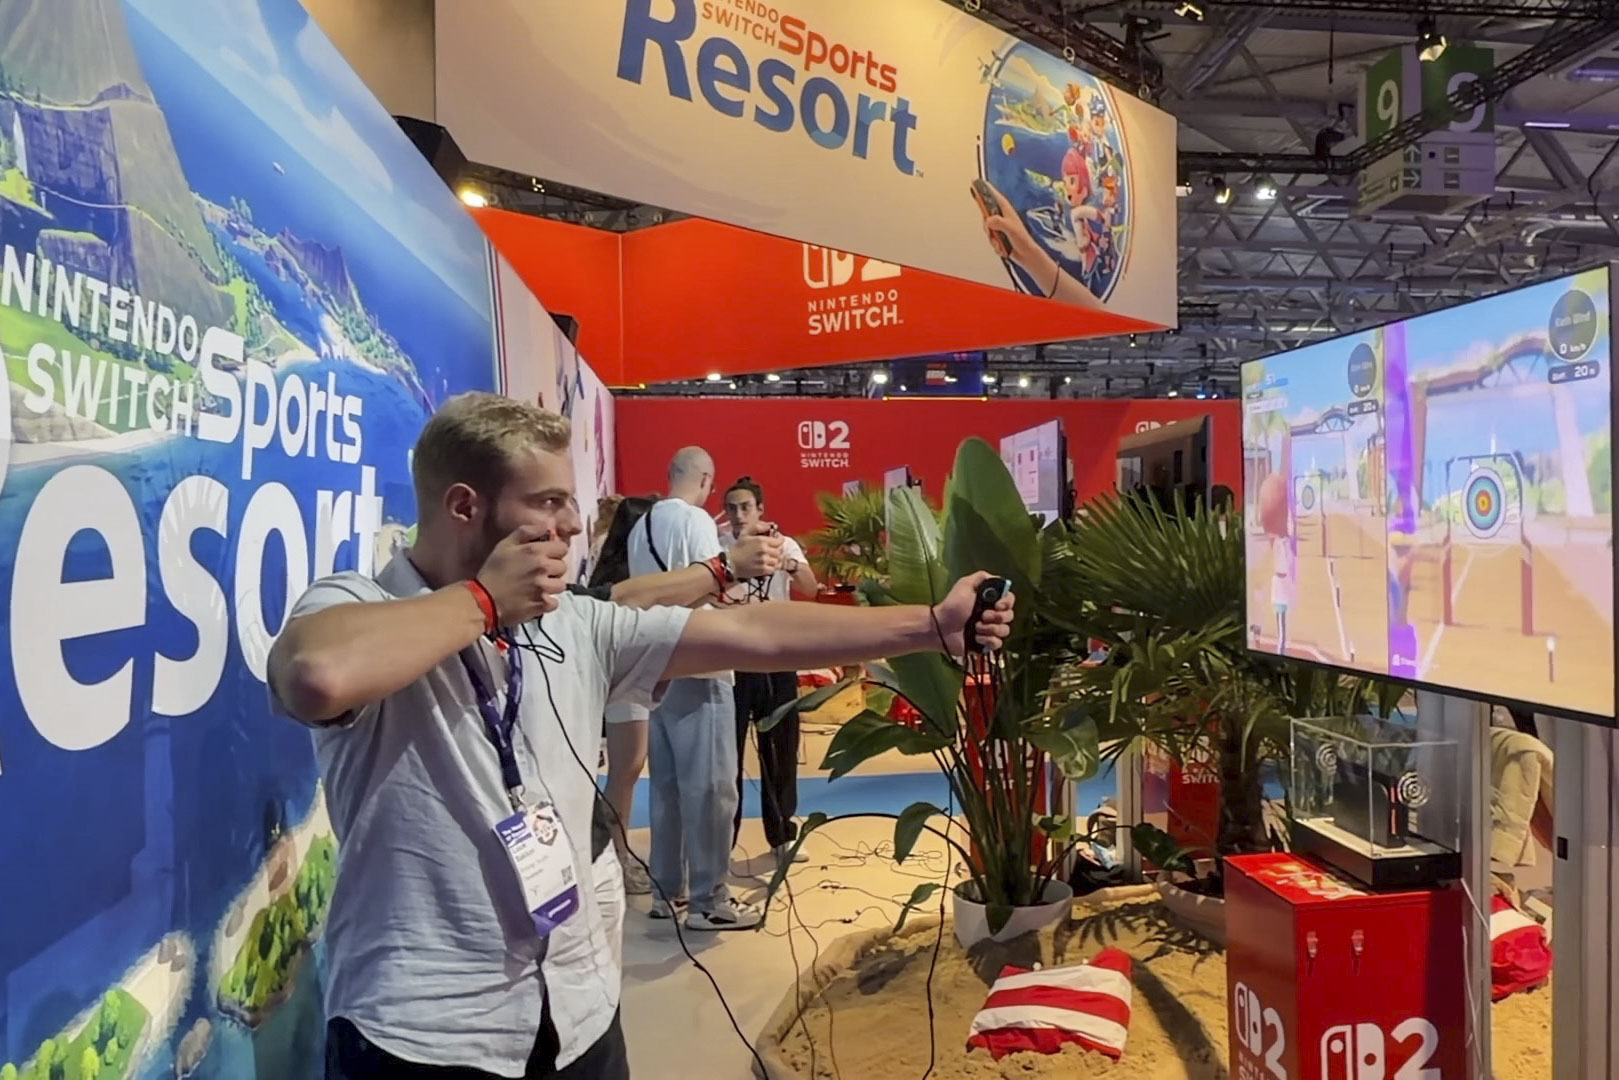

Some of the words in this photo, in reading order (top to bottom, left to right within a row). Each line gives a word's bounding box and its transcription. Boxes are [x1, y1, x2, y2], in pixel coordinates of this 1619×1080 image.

[727, 0, 779, 24] ENDO
[701, 2, 776, 47] SWITCH
[778, 15, 897, 93] Sports
[616, 0, 917, 176] Resort
[1377, 79, 1398, 131] 9
[2, 244, 199, 363] NINTENDO
[808, 289, 898, 312] NINTENDO
[808, 304, 898, 335] SWITCH
[1574, 365, 1589, 378] 20
[22, 343, 194, 437] SWITCH
[195, 326, 363, 480] Sports
[800, 458, 849, 468] SWITCH
[828, 420, 850, 449] 2
[0, 345, 383, 751] esort
[1263, 1007, 1288, 1080] 2
[1391, 1017, 1442, 1080] 2
